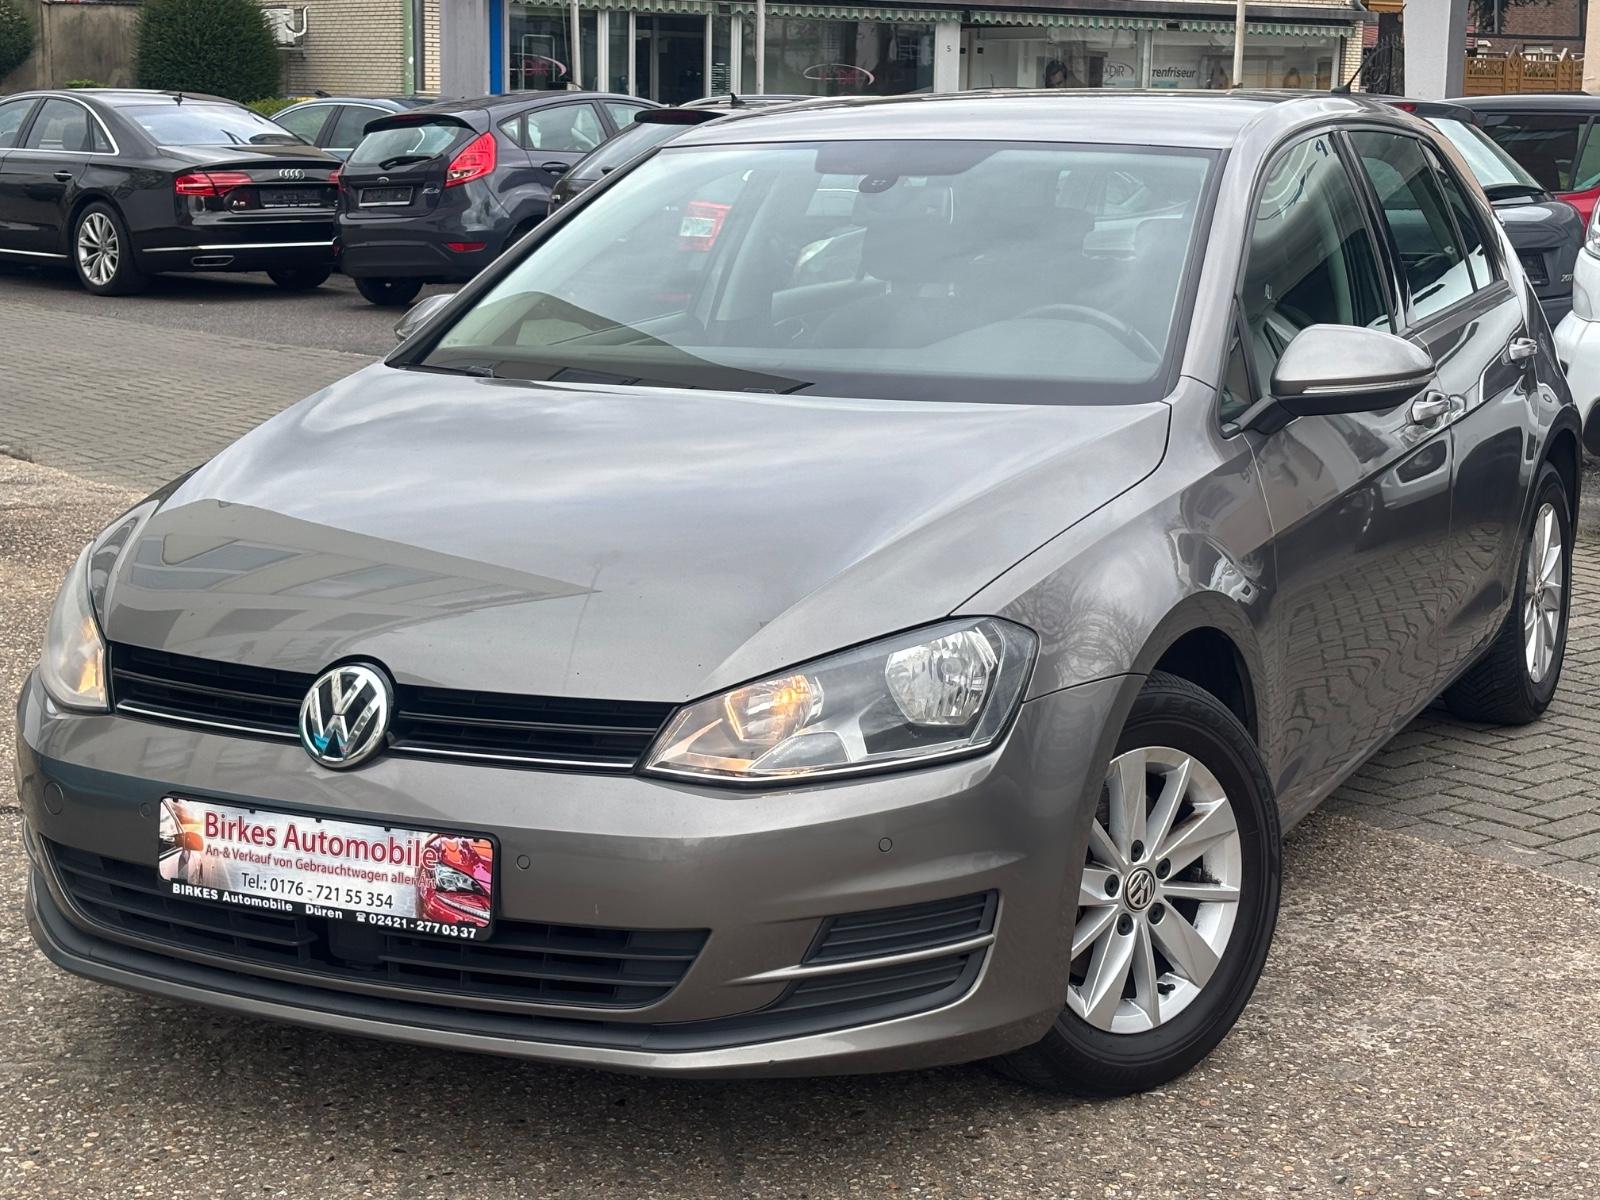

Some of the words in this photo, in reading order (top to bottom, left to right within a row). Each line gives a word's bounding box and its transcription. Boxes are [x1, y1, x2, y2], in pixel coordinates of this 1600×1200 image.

[204, 812, 277, 847] Birkes
[283, 824, 438, 870] Automobile
[232, 848, 272, 865] Verkauf
[273, 858, 293, 869] von
[295, 858, 388, 883] Gebrauchtwagen
[172, 882, 219, 900] BIRKES
[222, 891, 293, 912] Automobile
[305, 904, 343, 919] Düren
[242, 872, 267, 891] Tel.:
[270, 877, 304, 896] 0176
[316, 884, 340, 902] 721
[344, 889, 362, 905] 55
[366, 892, 393, 909] 354
